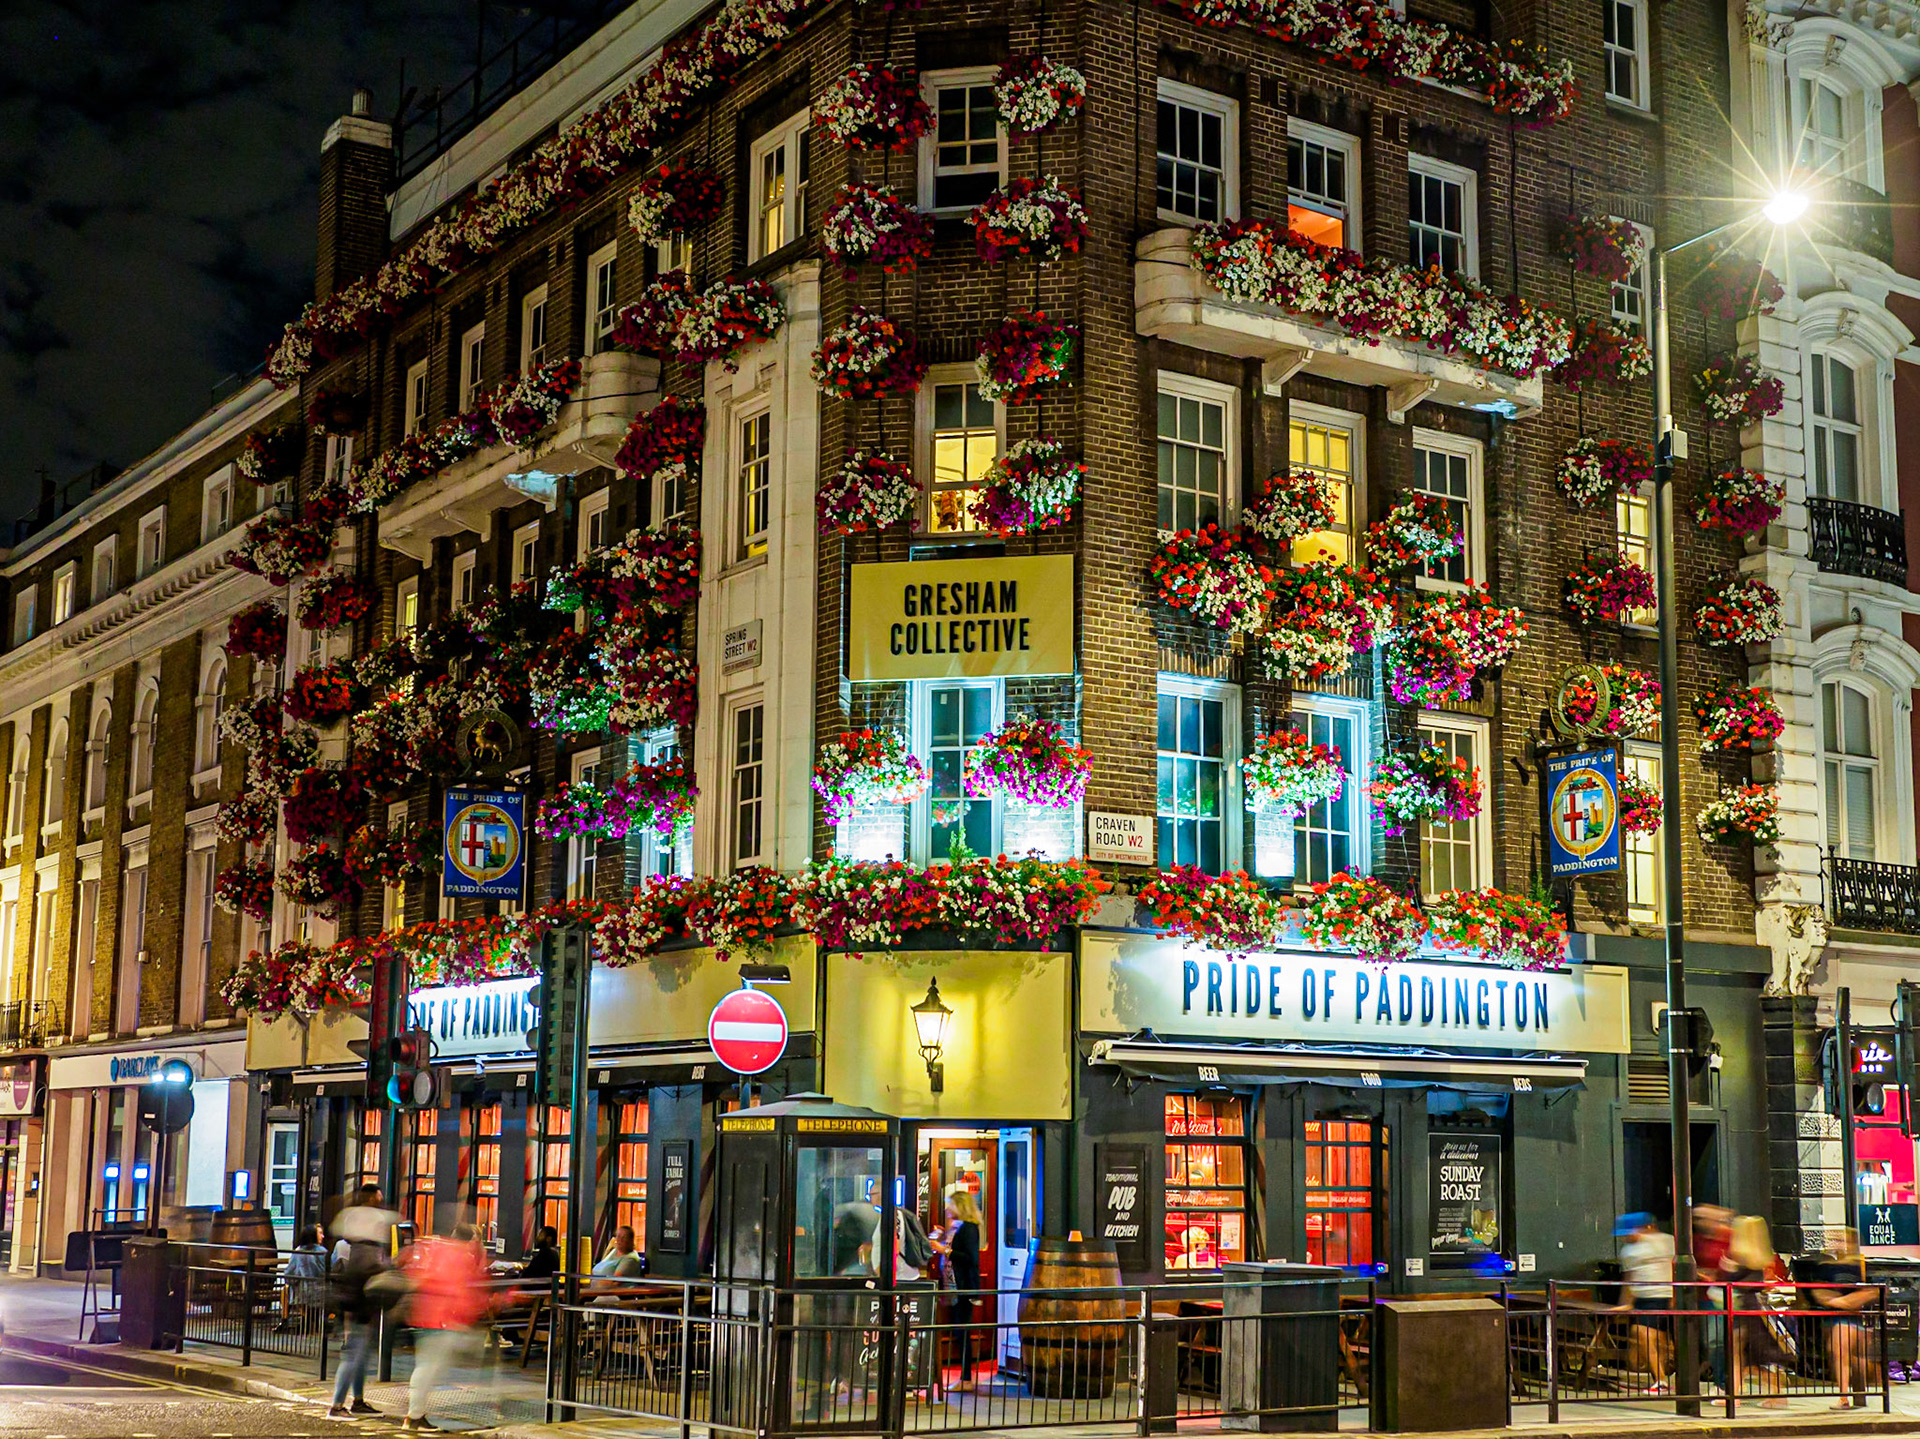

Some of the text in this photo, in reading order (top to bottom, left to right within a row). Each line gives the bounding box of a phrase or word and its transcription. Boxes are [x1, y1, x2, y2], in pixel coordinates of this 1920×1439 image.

[904, 580, 1017, 617] GRESHAM
[725, 628, 747, 646] SPRING
[890, 618, 1030, 656] COLLECTIVE
[725, 638, 757, 659] STREET W2
[1549, 753, 1614, 772] THE PRIDE OF
[449, 793, 521, 804] THE PRIDE OF
[1096, 816, 1136, 832] CRAVEN
[1096, 832, 1143, 848] ROAD W2
[1115, 854, 1148, 862] WESTMINSTER
[1552, 857, 1617, 873] PADDINGTON
[446, 885, 518, 895] PADDINGTON
[1183, 960, 1550, 1029] PRIDE OF PADDINGTON
[441, 998, 458, 1039] OF
[119, 1056, 161, 1078] BARCLAYS
[692, 1065, 706, 1080] BEDS
[1198, 1066, 1220, 1082] BEER
[598, 1070, 610, 1084] FOOD
[1360, 1072, 1382, 1087] FOOD
[1513, 1077, 1533, 1092] BEDS
[727, 1118, 772, 1131] TELEPHONE
[803, 1119, 883, 1132] TELEPHONE
[1446, 1150, 1479, 1160] delicious
[1467, 1142, 1479, 1153] for
[667, 1156, 683, 1167] FULL
[665, 1167, 684, 1179] TABLE
[1105, 1173, 1138, 1182] TRADITIONAL
[1440, 1165, 1485, 1182] SUNDAY
[1107, 1186, 1137, 1211] PUB
[1440, 1183, 1482, 1201] ROAST
[1115, 1211, 1130, 1221] AND
[1104, 1224, 1139, 1238] KITCHEN
[1869, 1224, 1896, 1235] EQUAL
[1869, 1234, 1896, 1245] DANCE
